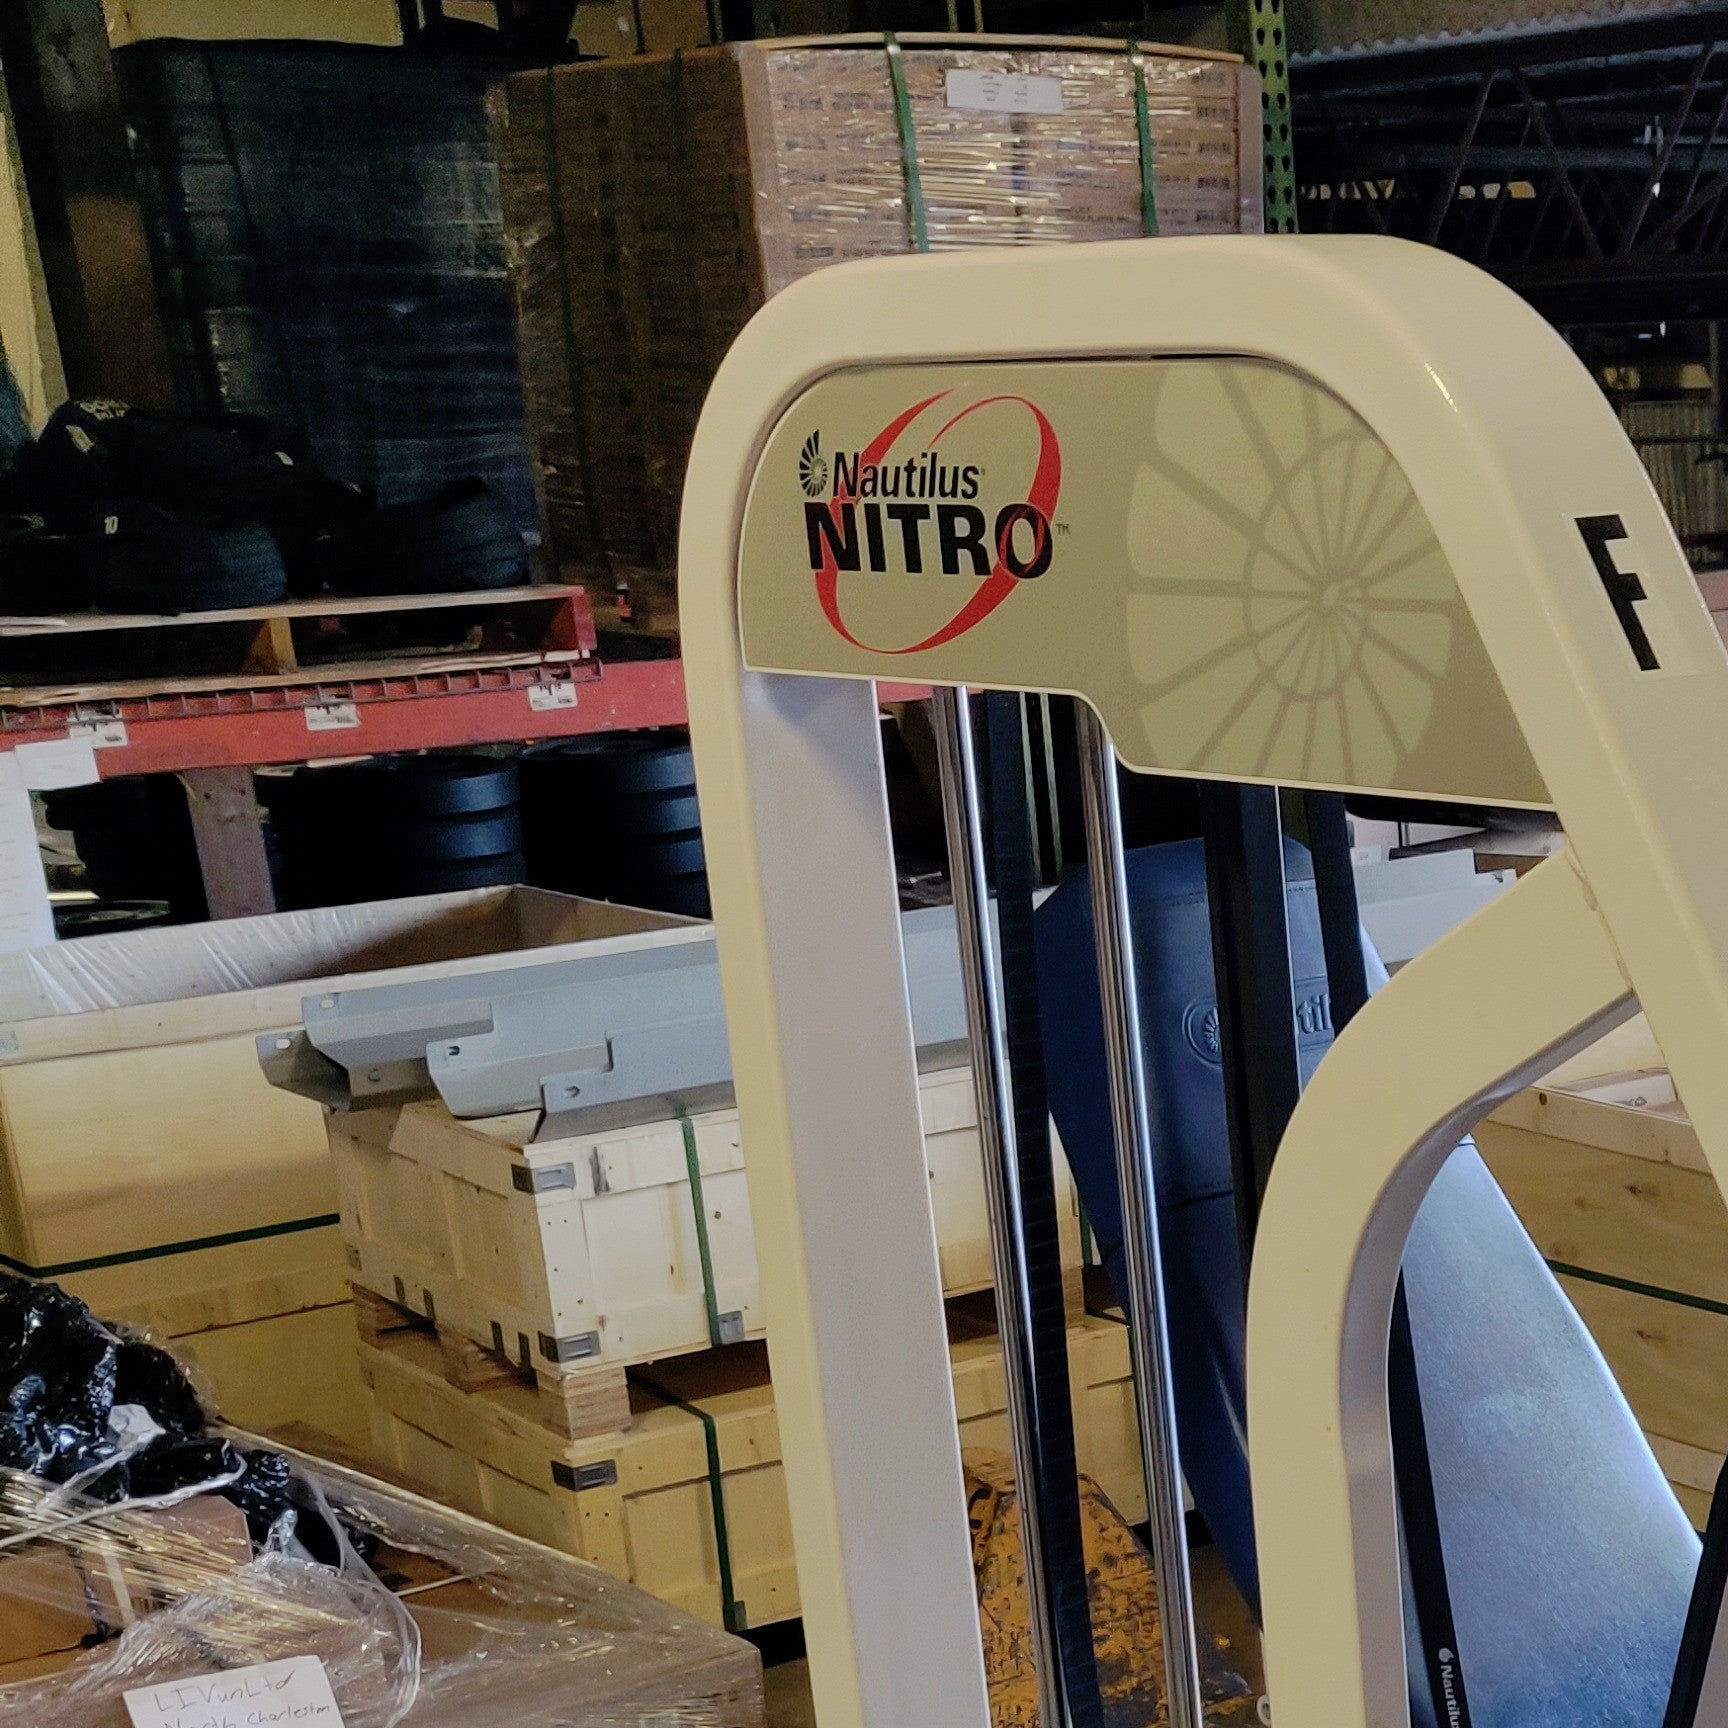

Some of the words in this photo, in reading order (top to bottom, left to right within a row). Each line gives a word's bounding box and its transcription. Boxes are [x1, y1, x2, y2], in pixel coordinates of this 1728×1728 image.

[833, 452, 980, 499] Nautilus
[804, 502, 1053, 579] NITRO
[1574, 514, 1661, 671] F
